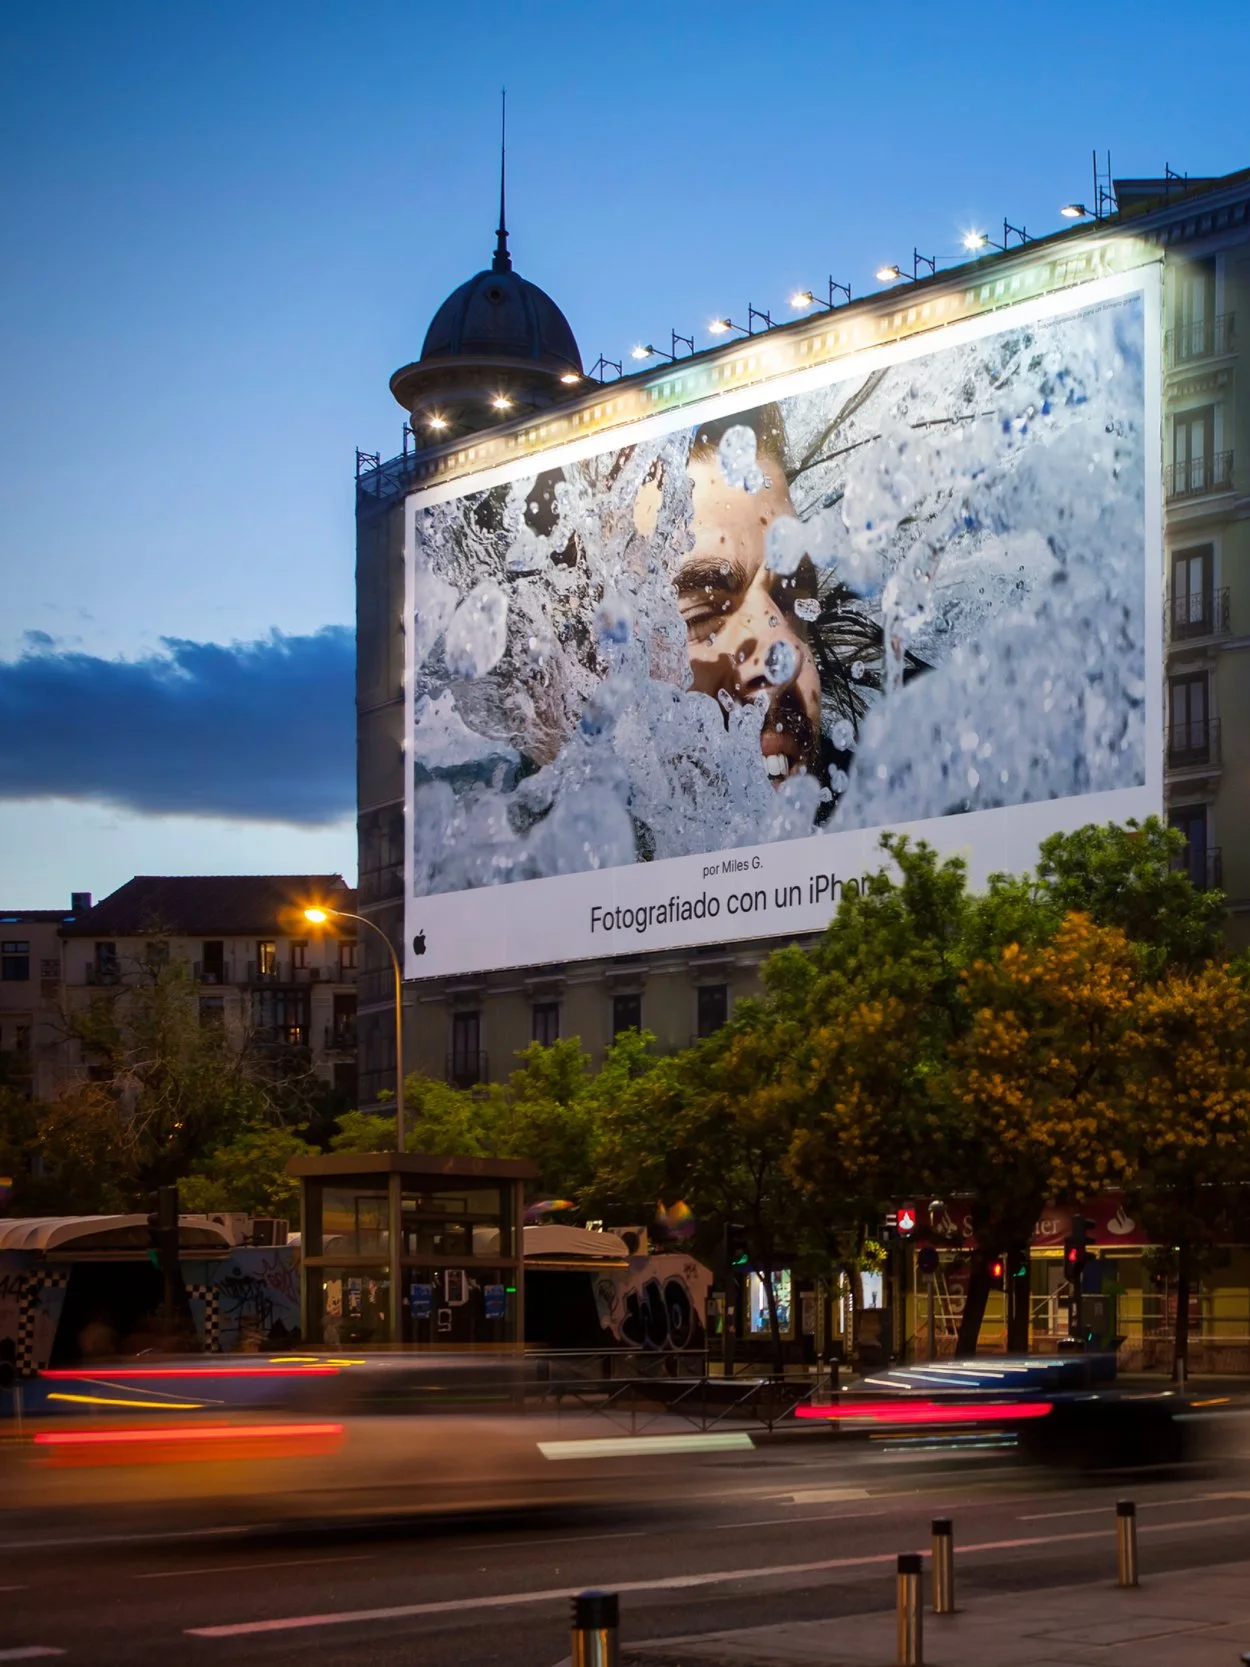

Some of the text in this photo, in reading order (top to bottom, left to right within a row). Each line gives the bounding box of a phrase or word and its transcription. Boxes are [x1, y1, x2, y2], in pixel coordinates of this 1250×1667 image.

[703, 855, 764, 880] por Miles G.
[591, 891, 720, 933] Fotografiado
[727, 888, 767, 915] con
[775, 885, 801, 907] un
